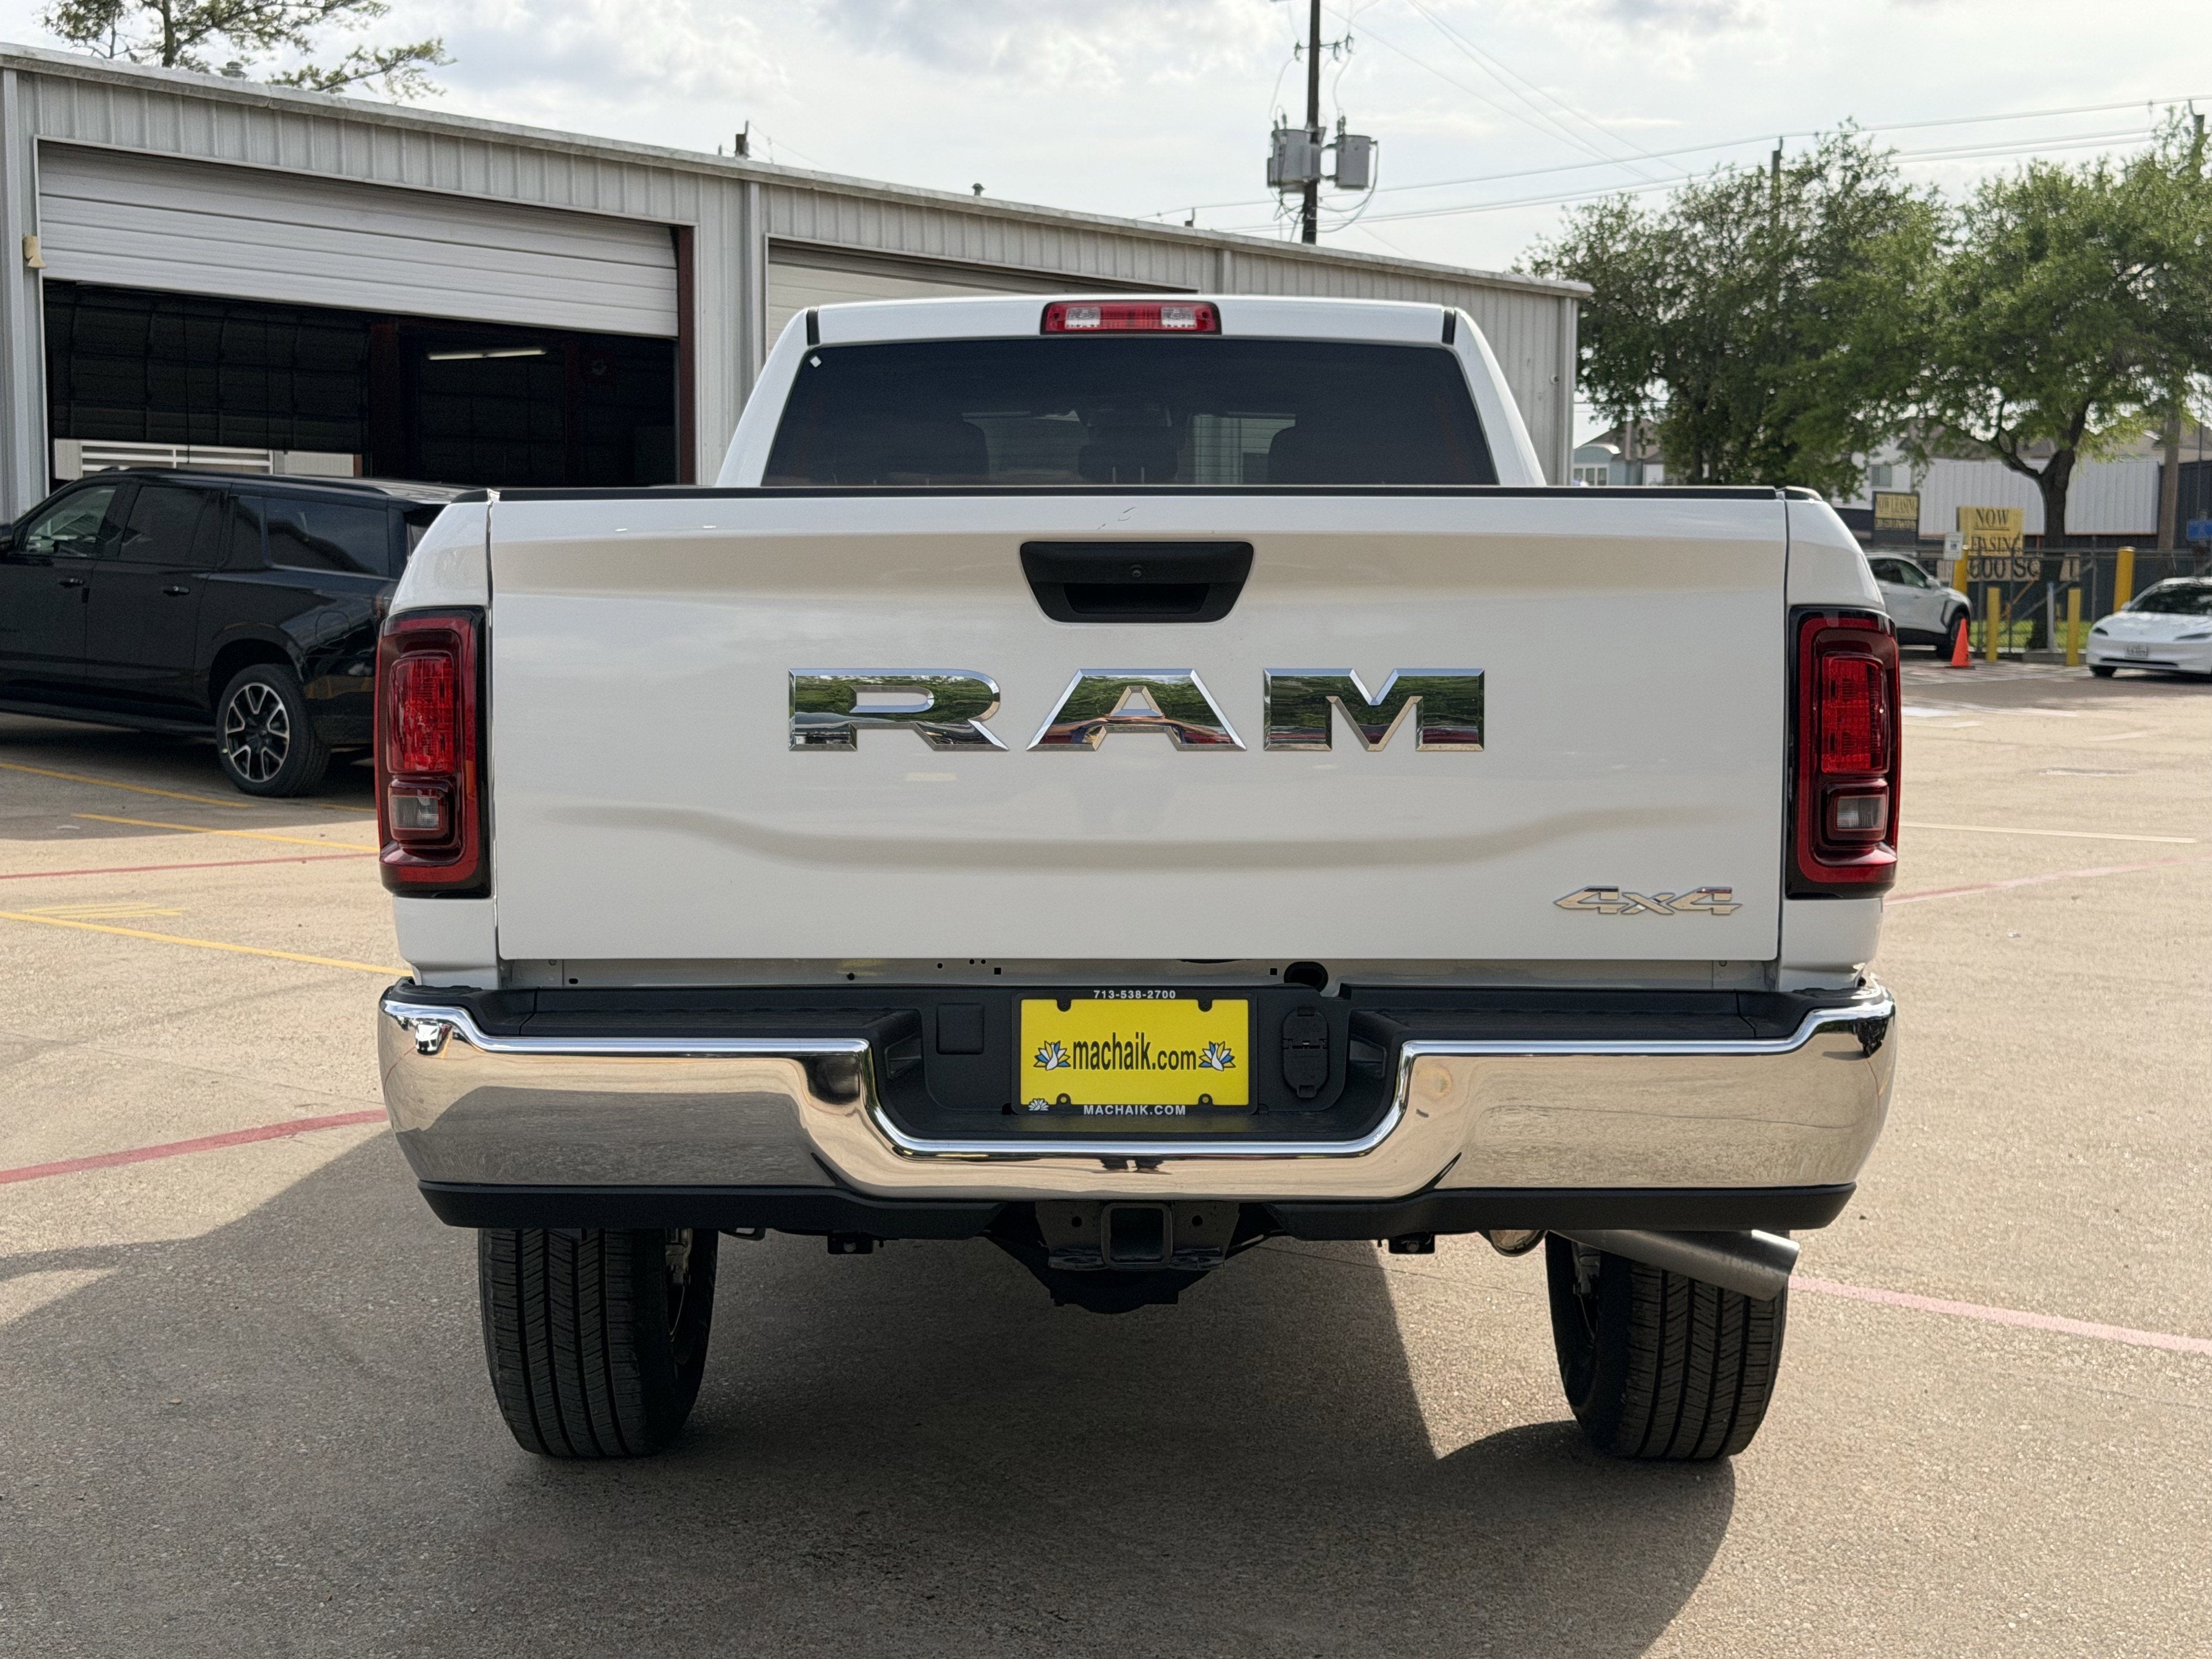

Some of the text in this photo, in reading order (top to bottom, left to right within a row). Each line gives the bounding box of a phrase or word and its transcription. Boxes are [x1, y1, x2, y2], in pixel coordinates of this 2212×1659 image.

[1976, 509, 2010, 527] NOW
[788, 669, 1485, 751] RAM
[1093, 990, 1176, 1000] 713-538-2700
[1073, 1031, 1197, 1070] machaik.com
[1083, 1105, 1186, 1115] MACHAIK.COM
